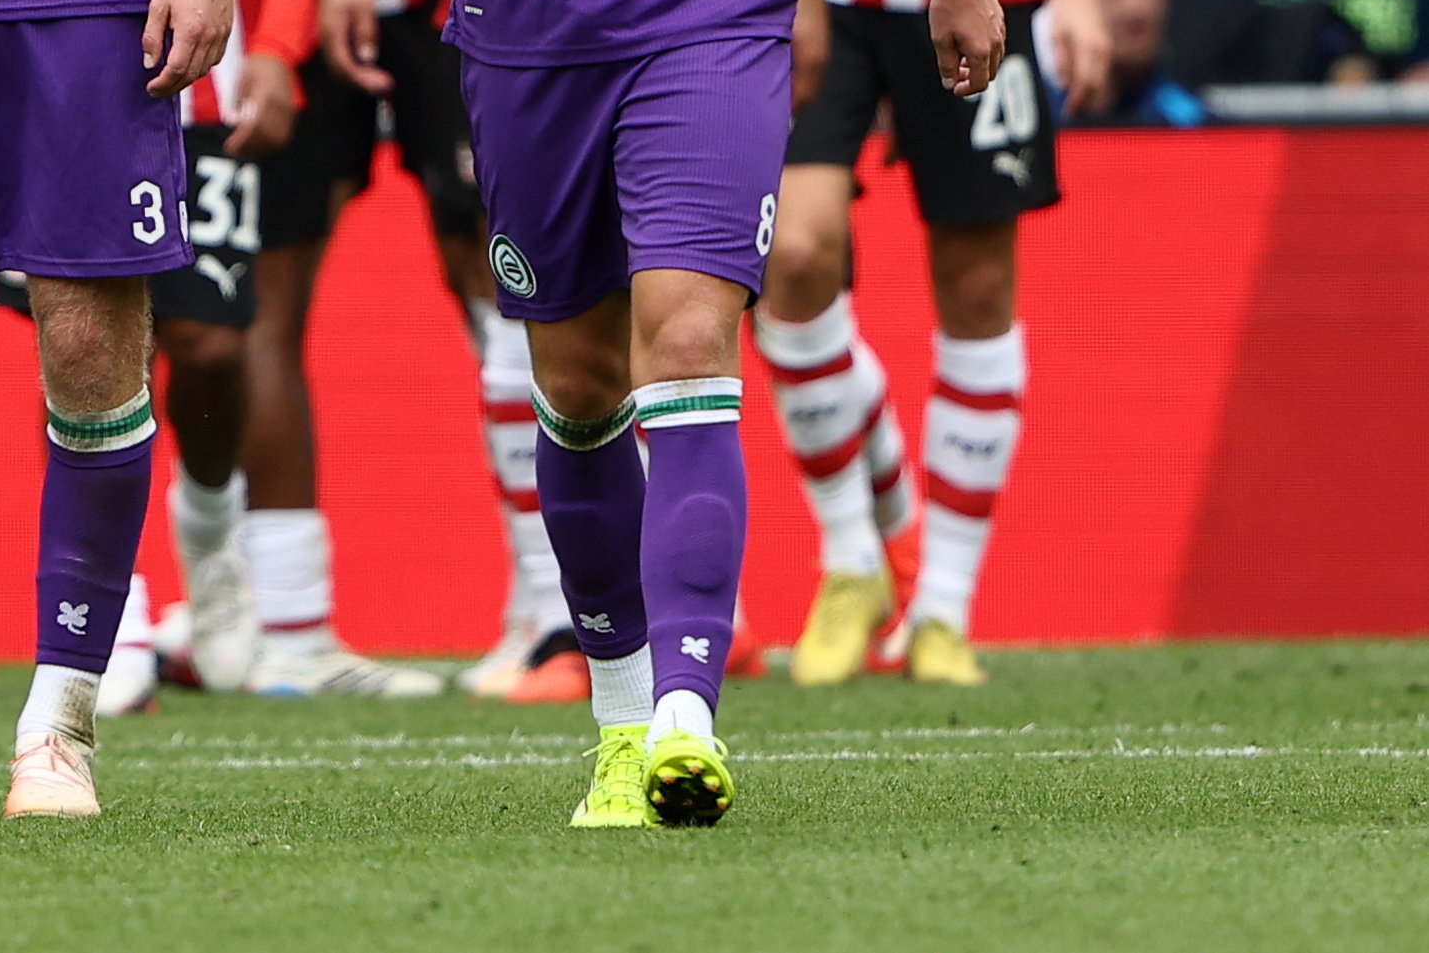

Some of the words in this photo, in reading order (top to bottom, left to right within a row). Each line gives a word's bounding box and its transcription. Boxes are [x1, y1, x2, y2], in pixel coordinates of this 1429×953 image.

[130, 180, 167, 245] 3
[189, 155, 263, 254] 31
[755, 193, 777, 256] 8
